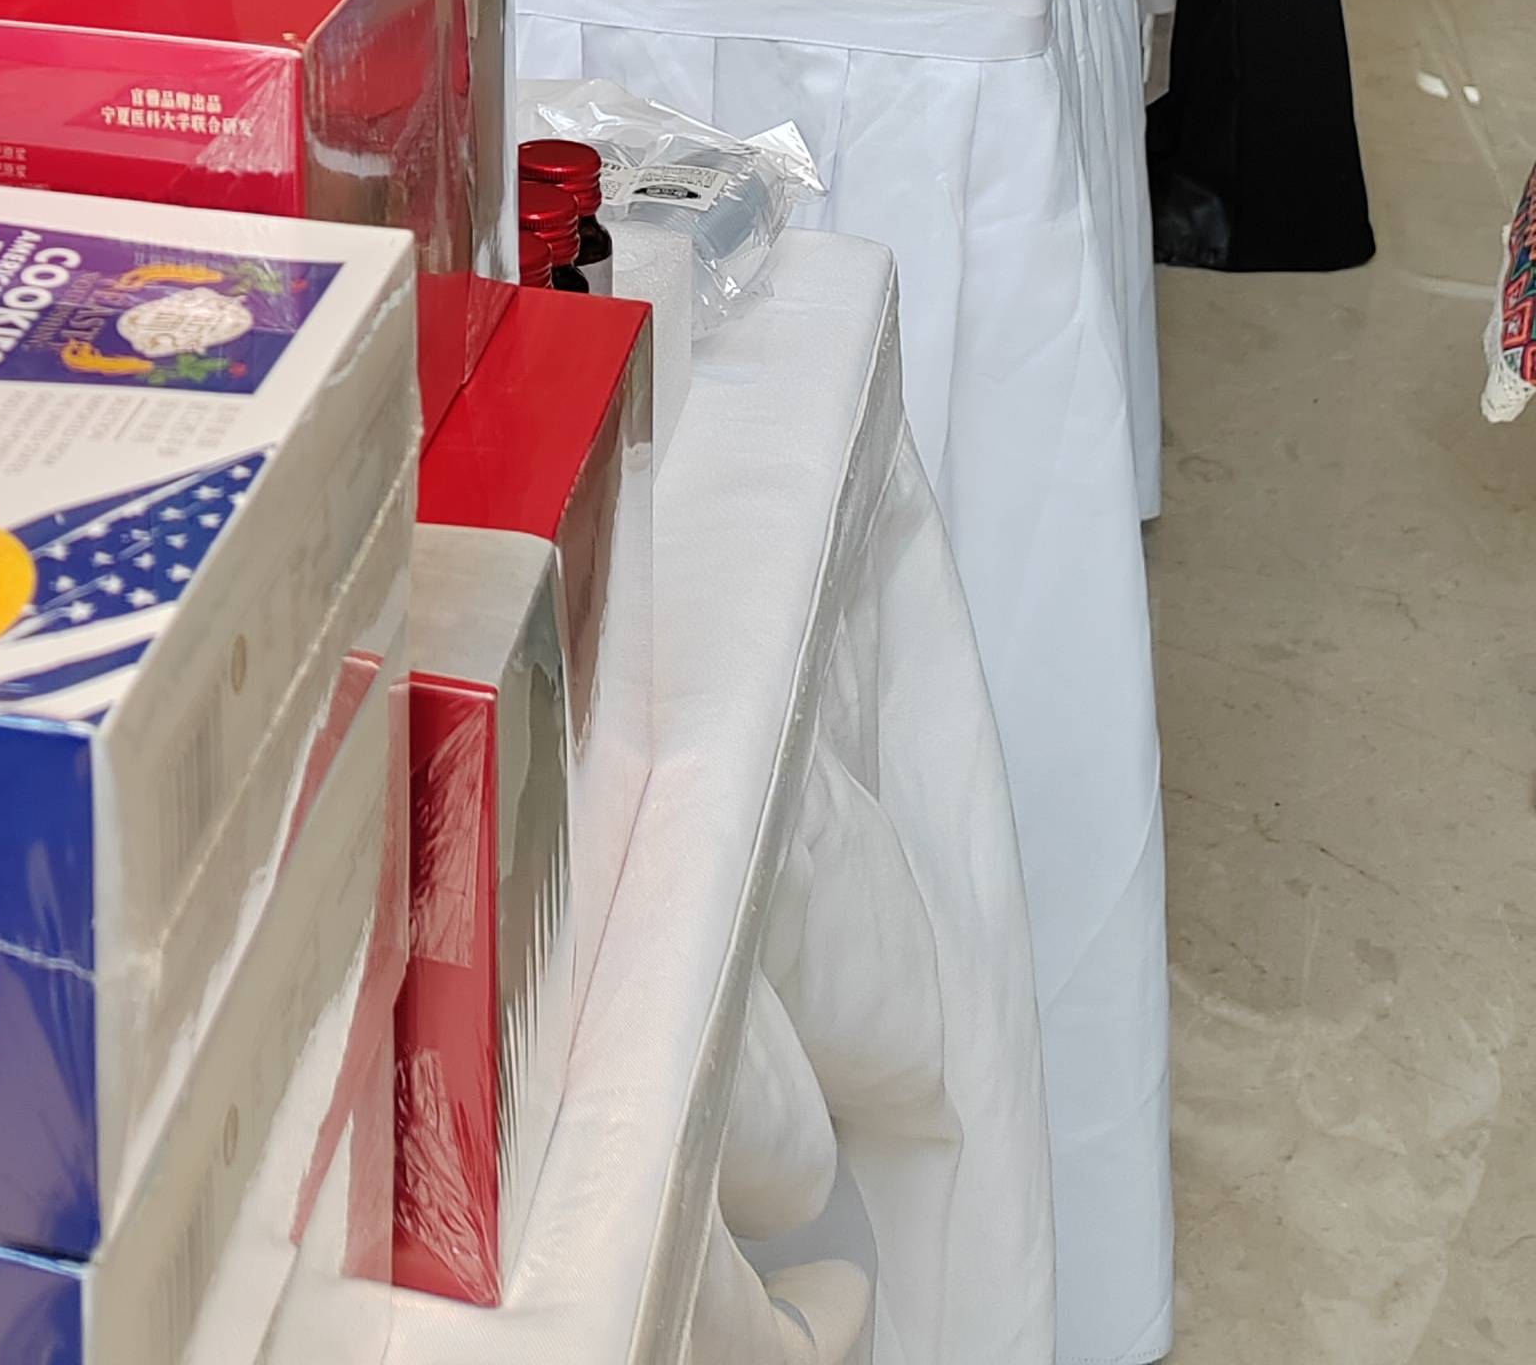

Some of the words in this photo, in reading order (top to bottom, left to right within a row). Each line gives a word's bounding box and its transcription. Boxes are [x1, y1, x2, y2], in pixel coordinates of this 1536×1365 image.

[130, 87, 222, 114] 官雅品牌出品
[100, 105, 254, 137] 宁夏医科大学联合研发
